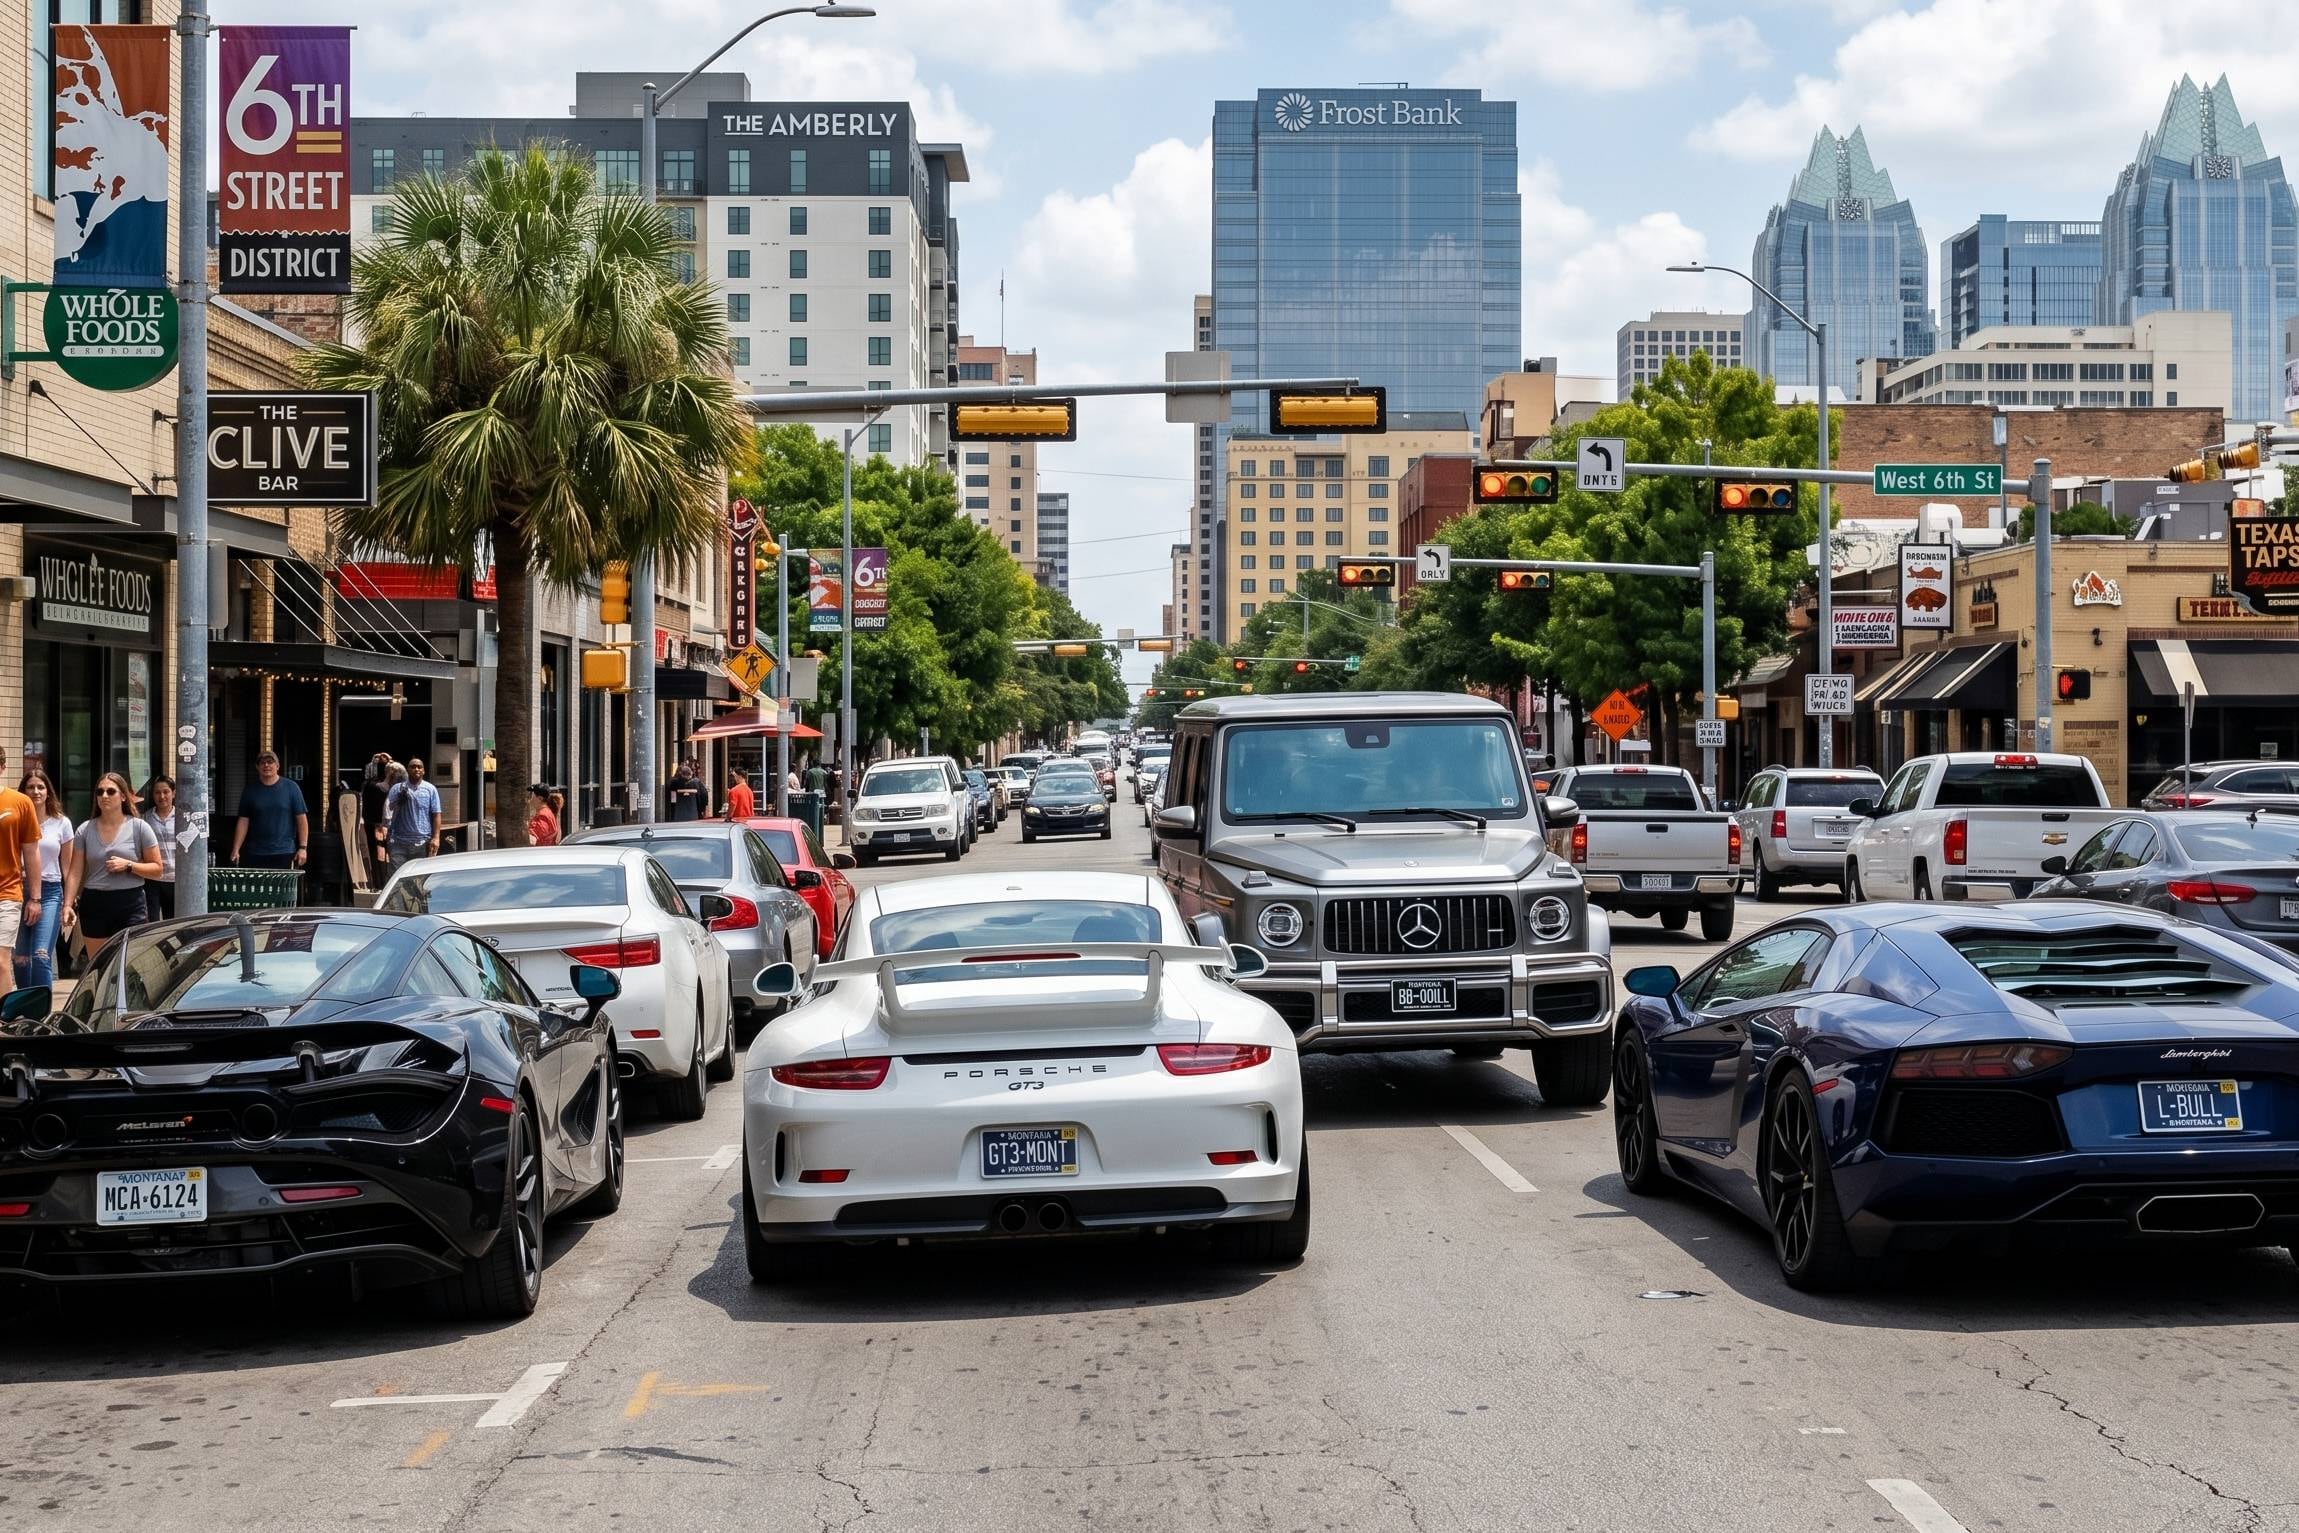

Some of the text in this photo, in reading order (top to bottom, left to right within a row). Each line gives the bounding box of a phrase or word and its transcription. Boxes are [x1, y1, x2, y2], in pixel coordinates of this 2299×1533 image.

[226, 55, 342, 156] 6TH
[1319, 99, 1462, 125] Frost Bank
[723, 113, 897, 136] THE AMBERLY
[227, 171, 343, 210] STREET
[230, 247, 340, 278] DISTRICT
[60, 288, 165, 318] WHOLE
[66, 320, 160, 344] FOODS
[260, 405, 298, 420] THE
[208, 426, 350, 469] CLIVE
[258, 475, 299, 491] BAR
[1881, 471, 1995, 490] West 6th St
[109, 568, 151, 614] FOODS
[943, 1064, 1107, 1080] PORSCHE
[1008, 1081, 1045, 1091] GT3
[2157, 1093, 2223, 1118] L-BULL
